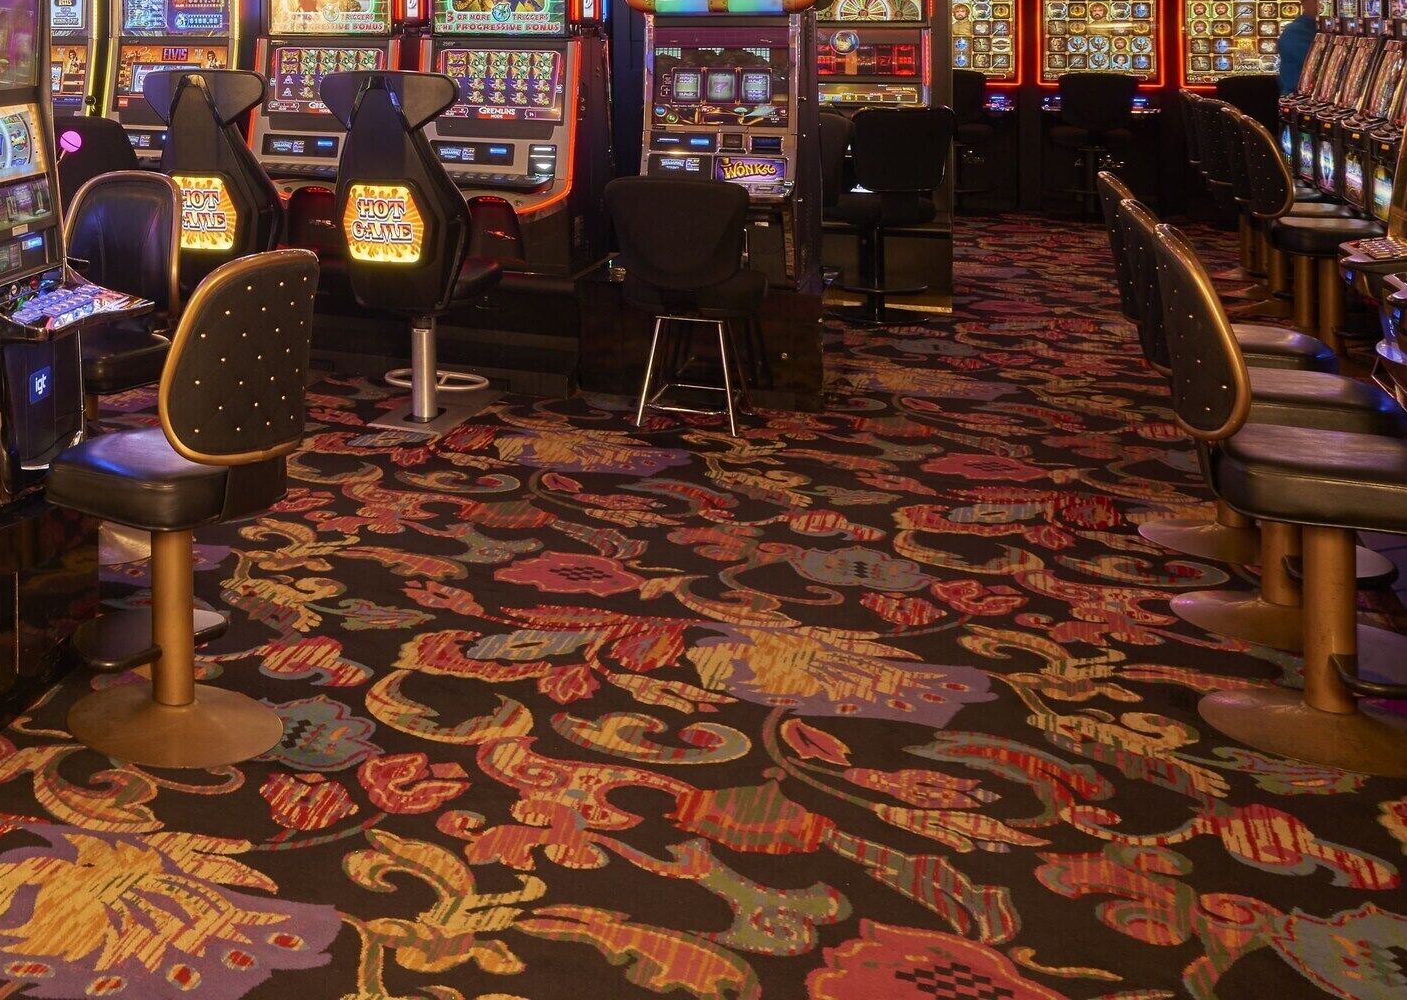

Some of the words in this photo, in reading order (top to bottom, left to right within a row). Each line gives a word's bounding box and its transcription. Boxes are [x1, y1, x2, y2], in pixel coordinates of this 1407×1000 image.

[447, 13, 454, 21] 3
[514, 13, 550, 21] TRIGGERS
[526, 23, 559, 31] BONUS
[163, 48, 188, 61] ELVIS
[724, 160, 777, 180] WONKA
[358, 198, 406, 219] HOT
[352, 221, 413, 244] GAME
[35, 374, 47, 395] igt
